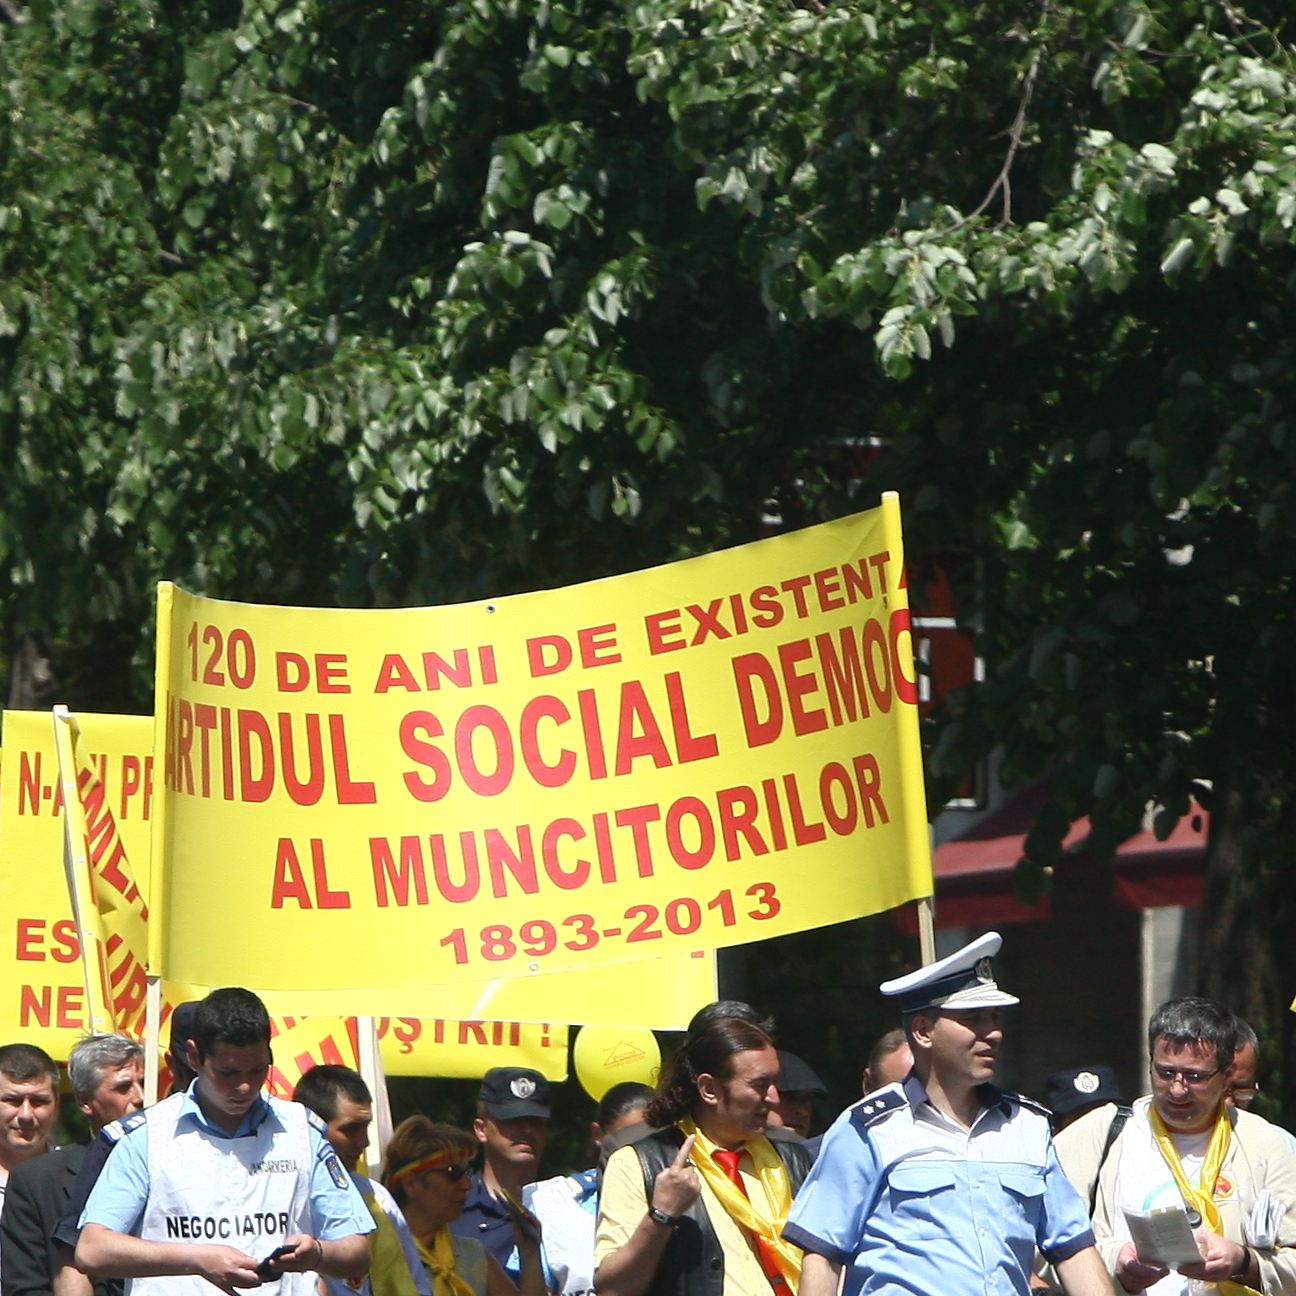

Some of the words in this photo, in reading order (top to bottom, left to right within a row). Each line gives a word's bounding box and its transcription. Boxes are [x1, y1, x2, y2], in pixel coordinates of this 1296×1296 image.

[188, 619, 257, 690] 120
[275, 650, 352, 695] DE
[373, 643, 498, 695] ANI
[526, 622, 624, 679] DE
[645, 550, 907, 657] EXISTENȚ
[398, 671, 719, 803] SOCIAL
[730, 607, 919, 749] DEMOC
[271, 837, 351, 911] AL
[369, 753, 891, 909] MUNCITORILOR
[440, 881, 782, 966] 1893-2013
[165, 1212, 290, 1239] NEGOCIATOR
